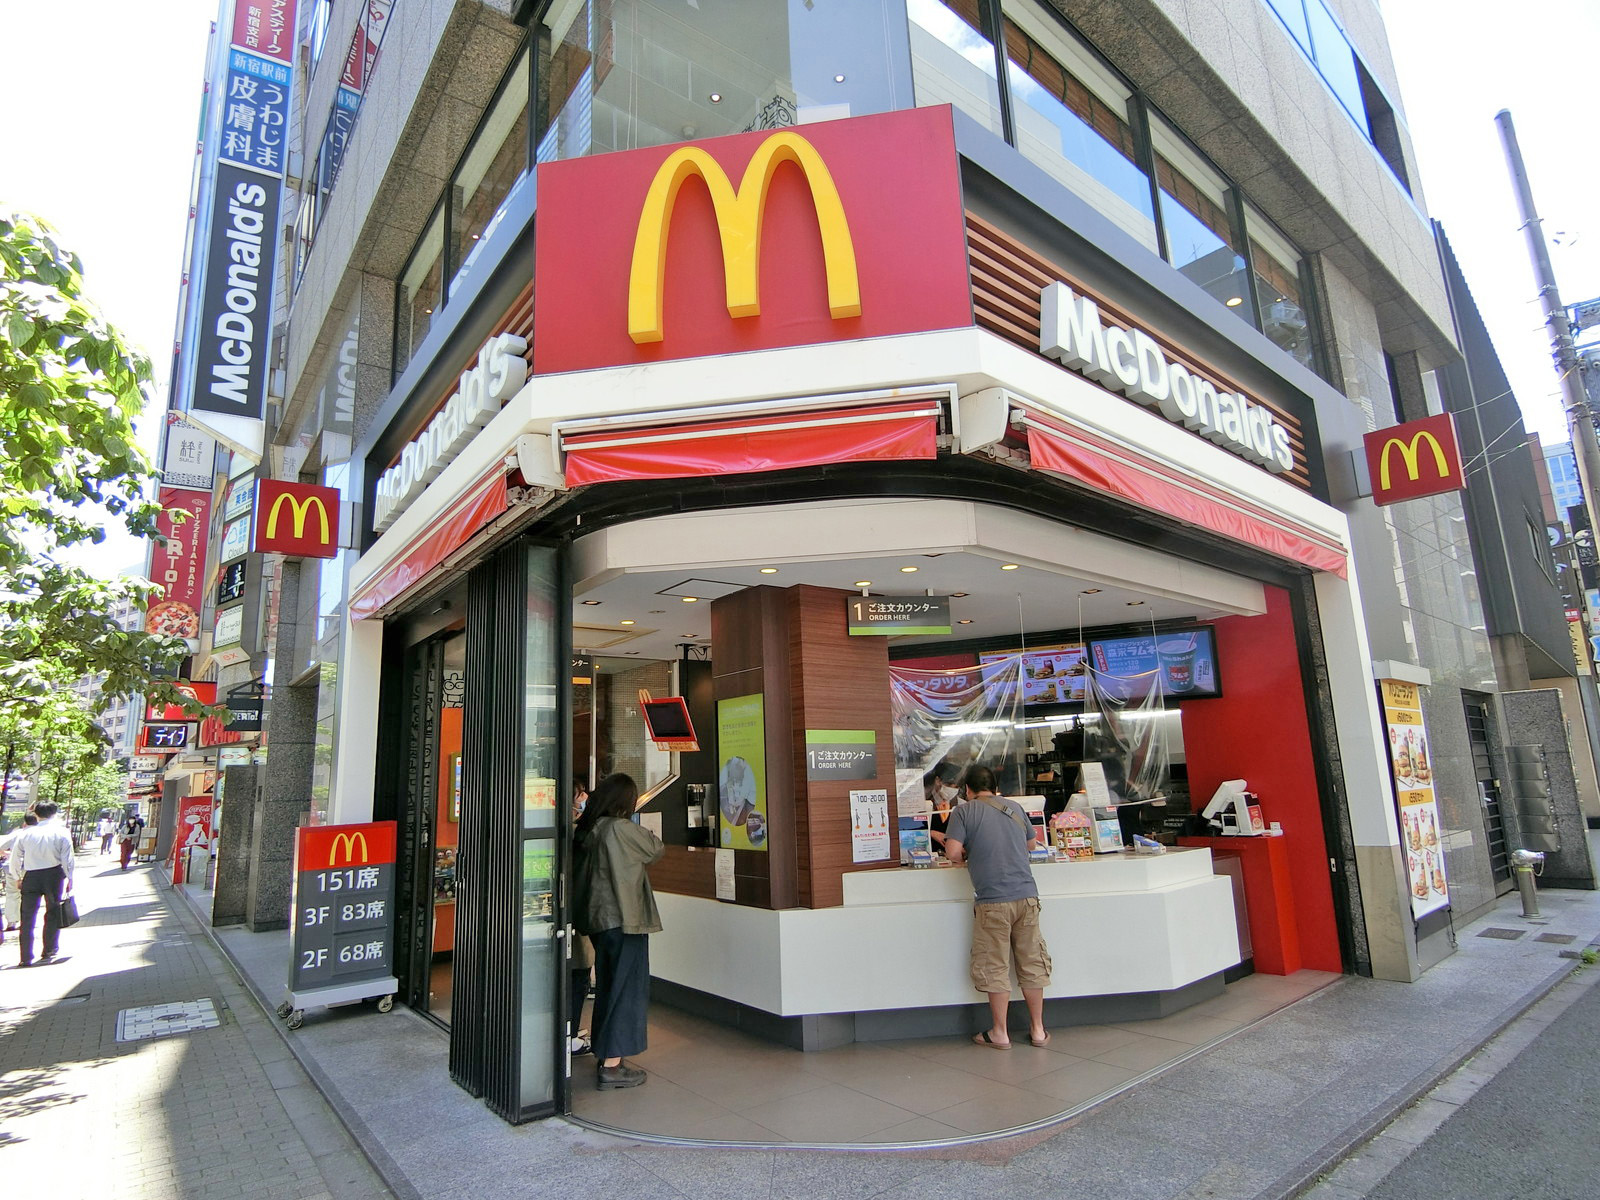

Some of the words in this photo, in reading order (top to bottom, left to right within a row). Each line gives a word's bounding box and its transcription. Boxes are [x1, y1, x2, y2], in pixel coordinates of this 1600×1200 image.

[246, 6, 262, 48] 新宿支店
[233, 53, 287, 83] 新宿駅前
[224, 75, 259, 161] 皮膚科
[256, 83, 284, 168] うわじま
[211, 182, 267, 405] McDonald's
[1040, 281, 1294, 474] McDonald's
[373, 332, 528, 533] McDonald's
[189, 507, 202, 559] PIZZERIA
[187, 566, 196, 587] BAR
[853, 603, 862, 621] 1
[868, 602, 939, 613] ご注文カウンター
[809, 751, 815, 769] 1
[818, 751, 873, 760] ご注文カウンター
[317, 867, 380, 892] 151席
[304, 906, 330, 926] 3F
[341, 900, 385, 921] 83席
[302, 948, 329, 969] 2F
[339, 941, 384, 962] 68席
